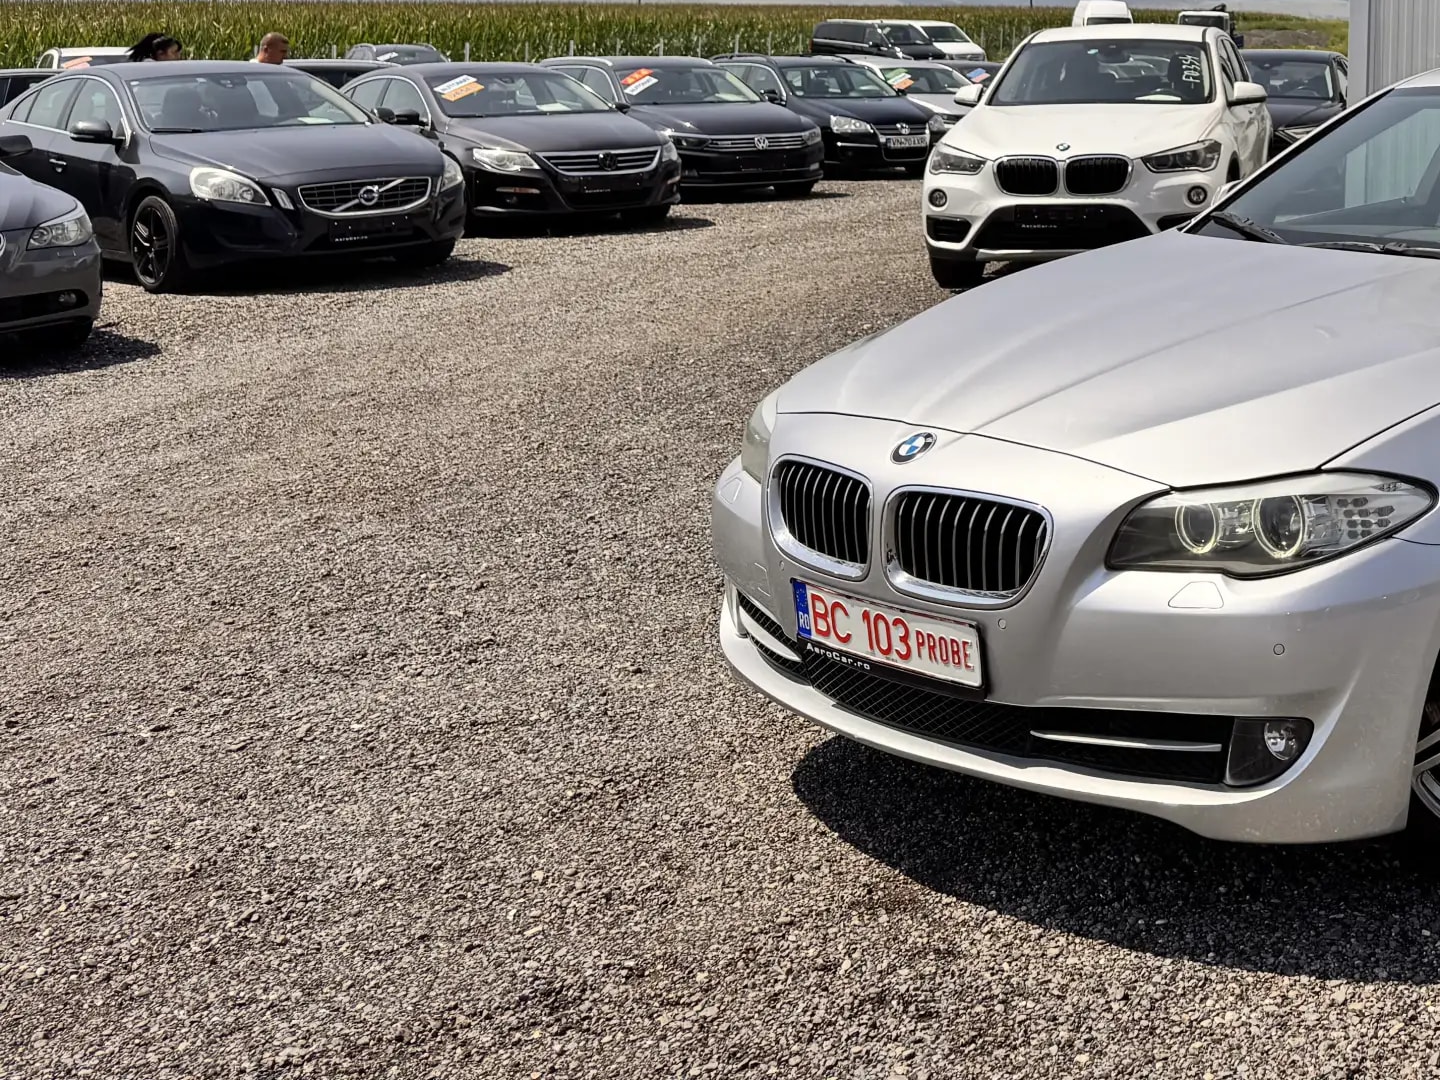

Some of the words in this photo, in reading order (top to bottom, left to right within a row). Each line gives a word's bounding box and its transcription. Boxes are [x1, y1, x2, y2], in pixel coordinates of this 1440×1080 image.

[799, 612, 811, 630] RO
[810, 592, 852, 644] BC
[861, 609, 912, 661] 103
[915, 630, 974, 670] PROBE
[806, 642, 871, 671] AeroCar.ro
